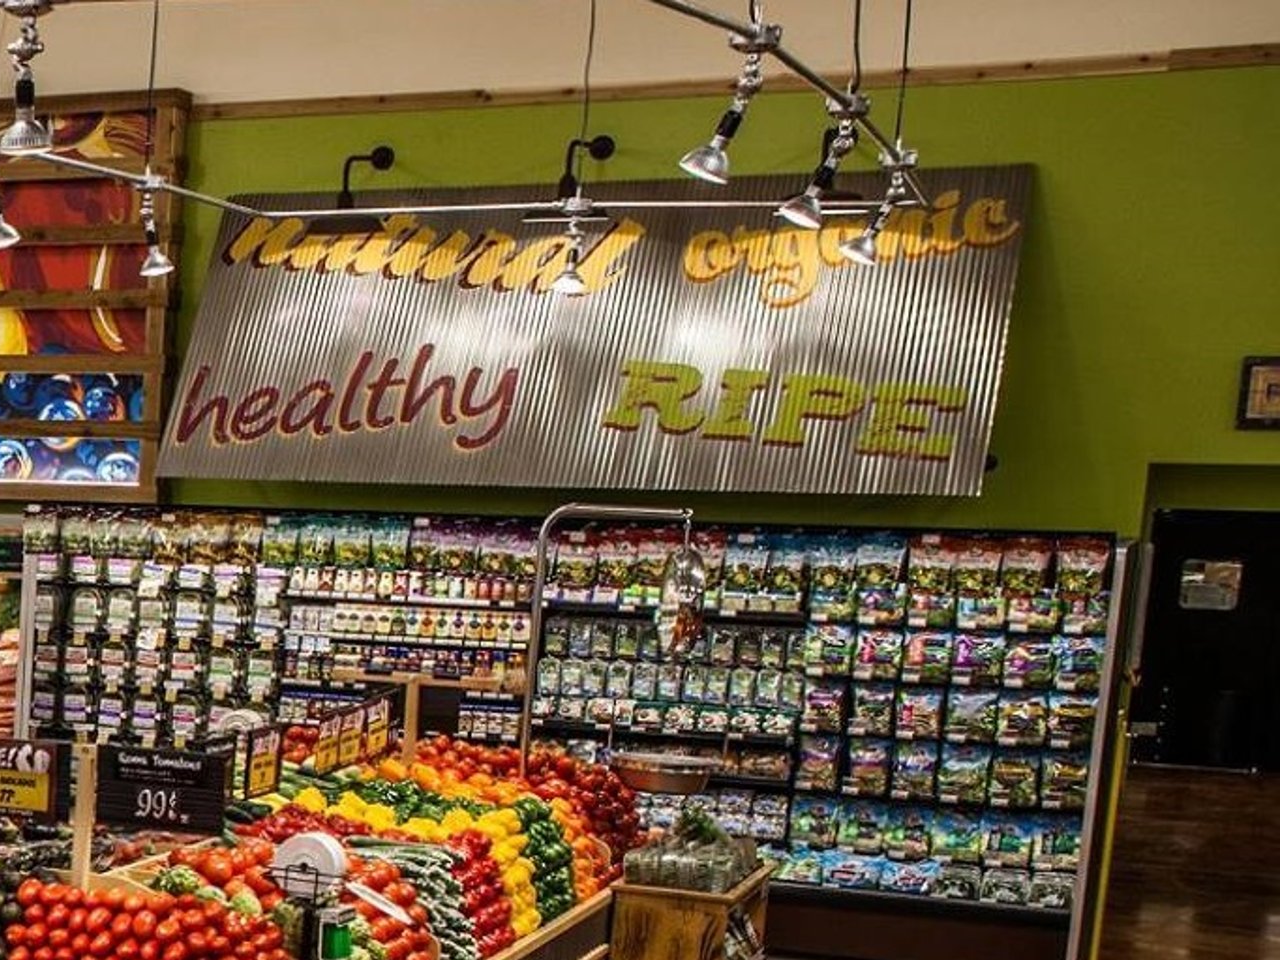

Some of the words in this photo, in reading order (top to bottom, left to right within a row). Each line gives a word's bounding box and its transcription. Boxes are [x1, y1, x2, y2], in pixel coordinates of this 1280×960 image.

[682, 191, 1021, 308] organic
[176, 343, 519, 450] healthy
[600, 358, 970, 461] RIPE
